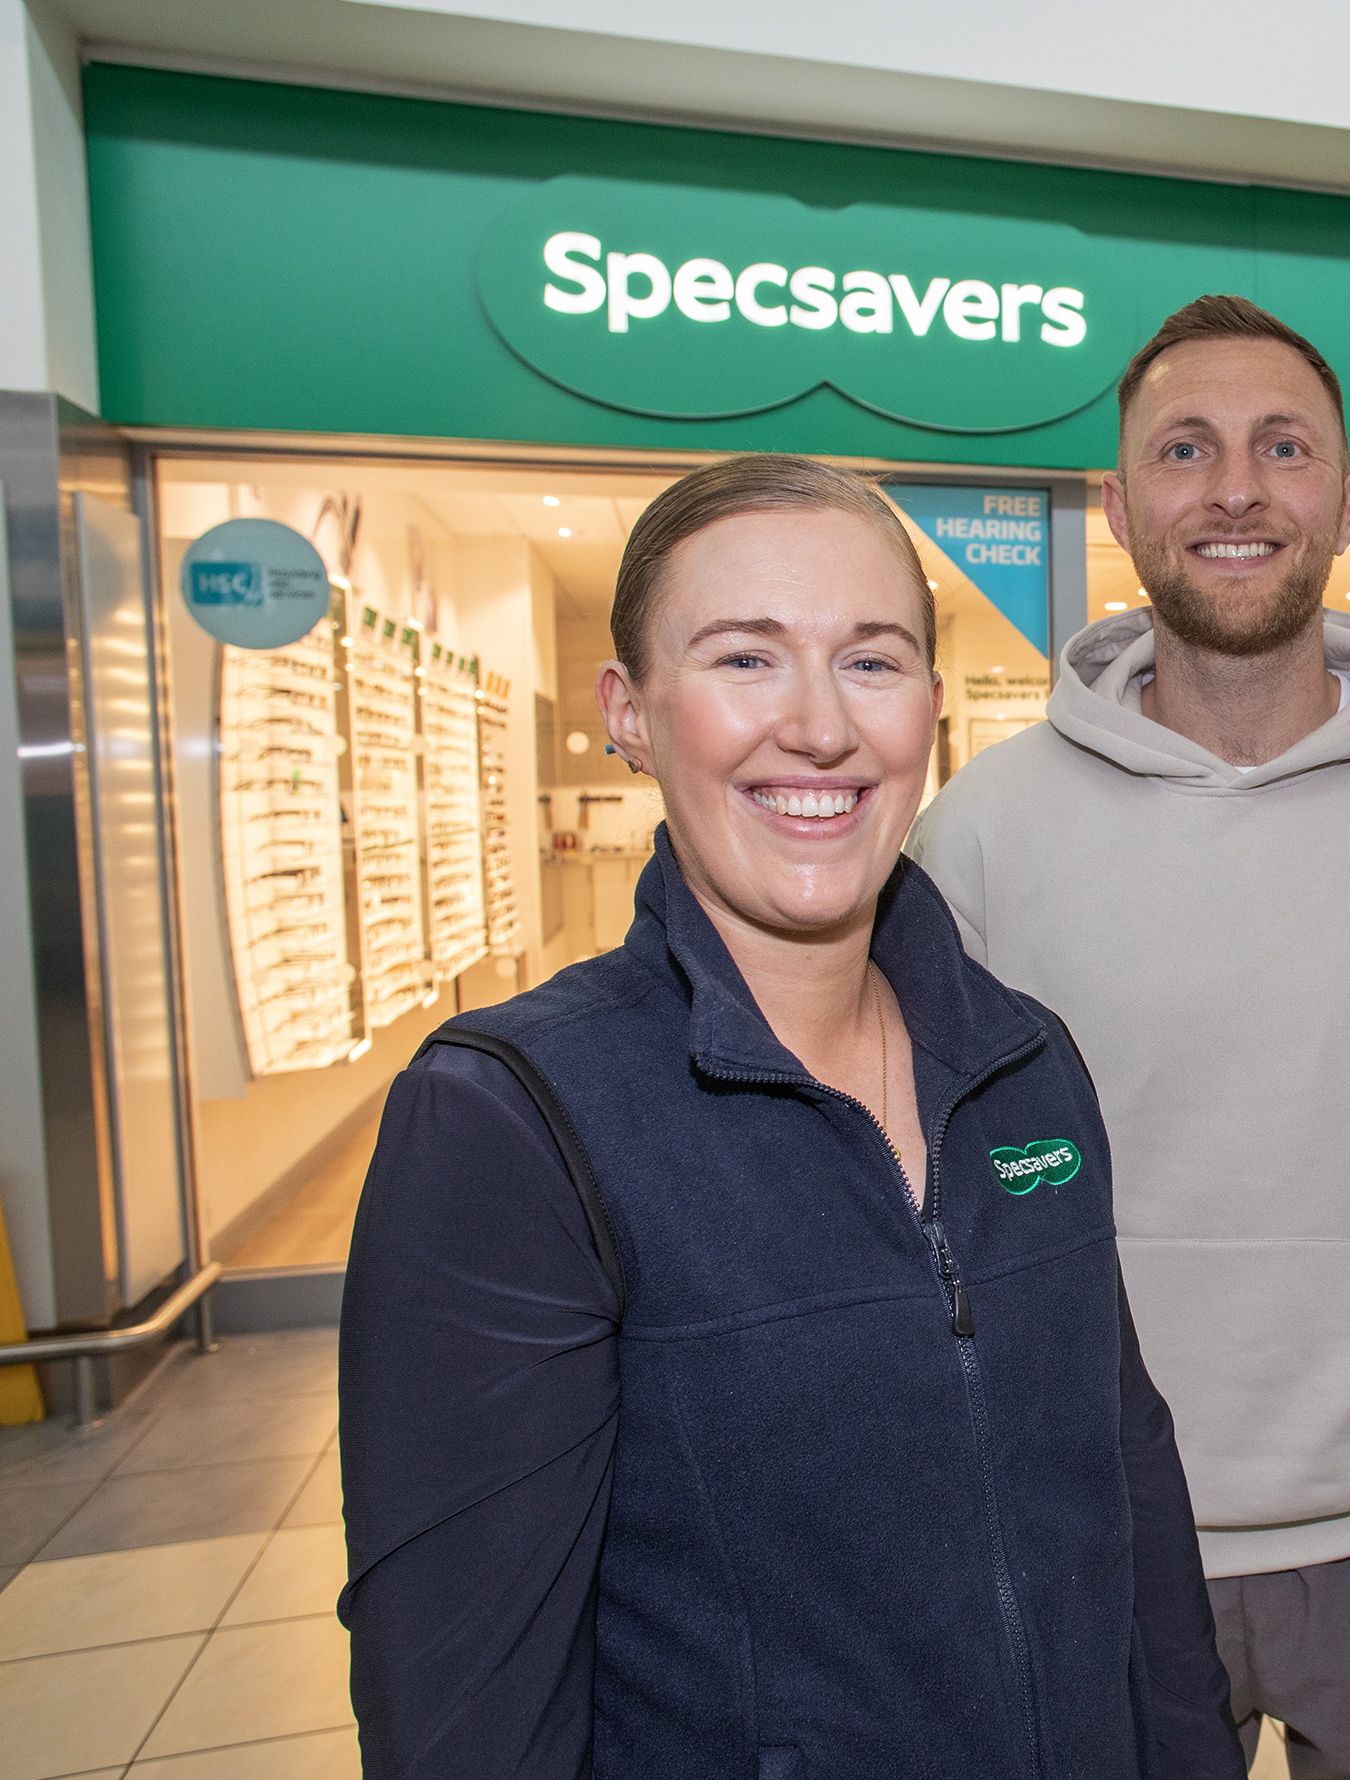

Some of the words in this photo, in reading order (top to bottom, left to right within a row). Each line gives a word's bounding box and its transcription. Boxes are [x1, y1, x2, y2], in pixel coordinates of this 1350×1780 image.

[543, 231, 1087, 348] Specsavers
[983, 495, 1041, 516] FREE
[935, 517, 1042, 542] HEARING
[965, 543, 1042, 566] CHECK
[199, 572, 250, 596] HSC
[993, 1146, 1073, 1182] Specsavers
